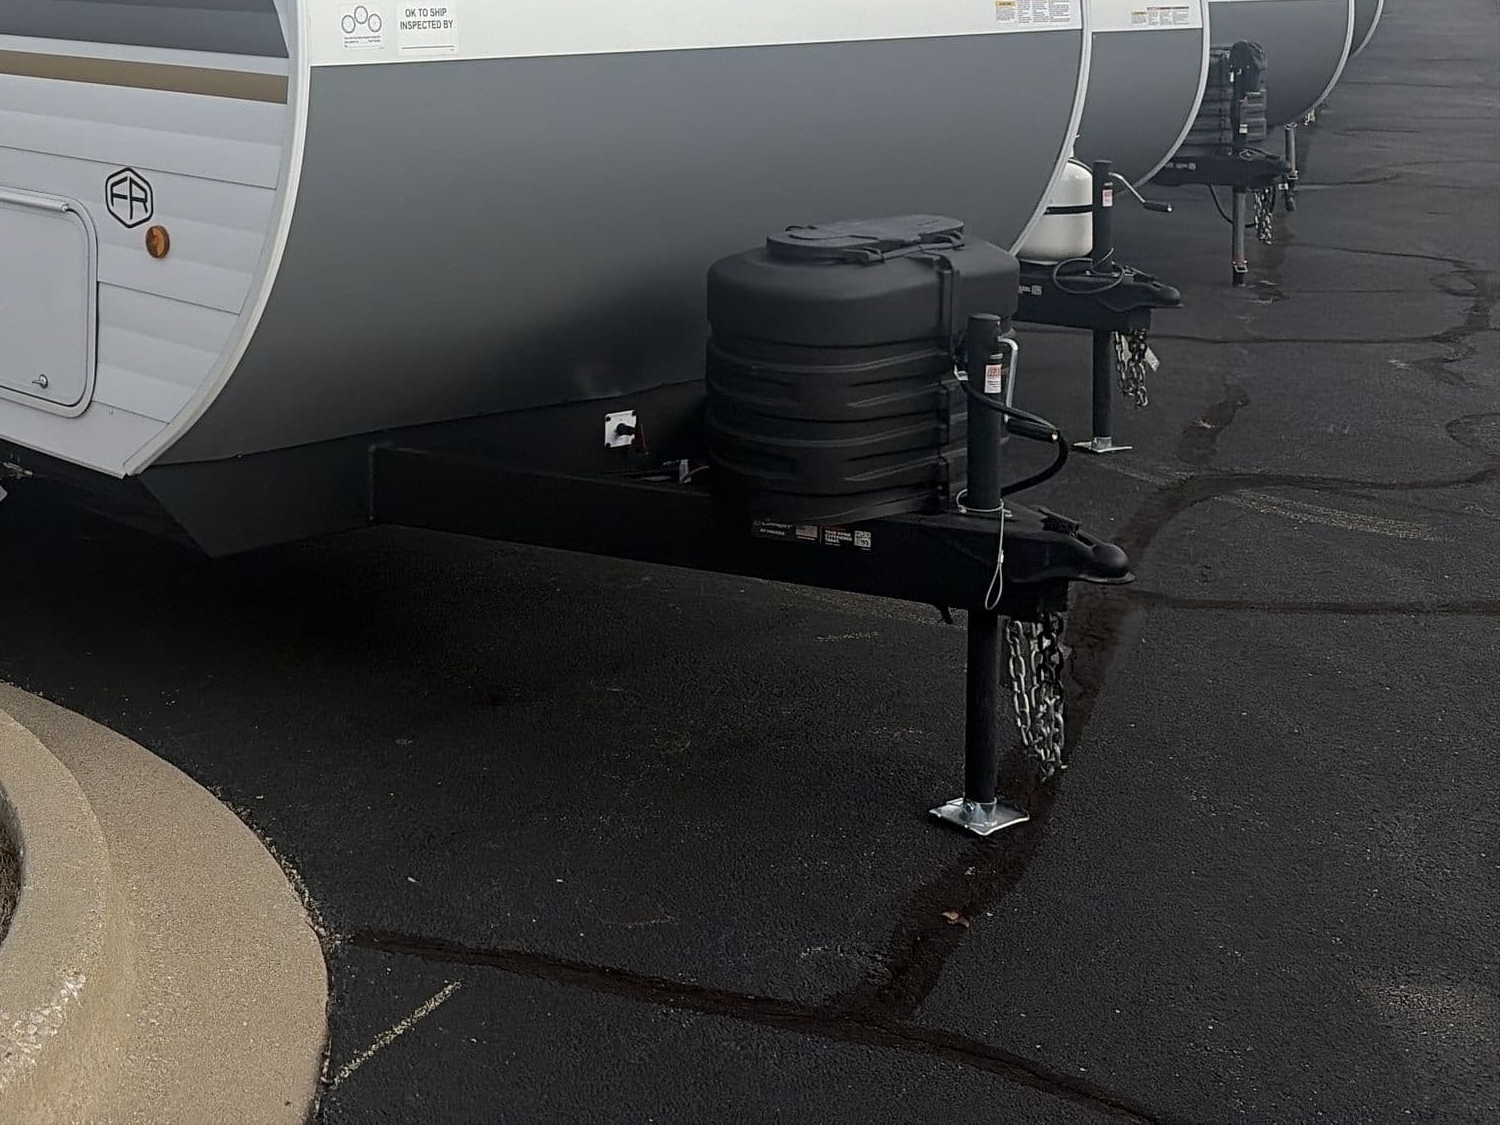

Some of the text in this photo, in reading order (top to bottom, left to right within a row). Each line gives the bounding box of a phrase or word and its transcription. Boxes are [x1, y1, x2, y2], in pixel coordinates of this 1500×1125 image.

[404, 7, 447, 18] OK TO SHIP
[399, 19, 454, 30] INSPECTED BY
